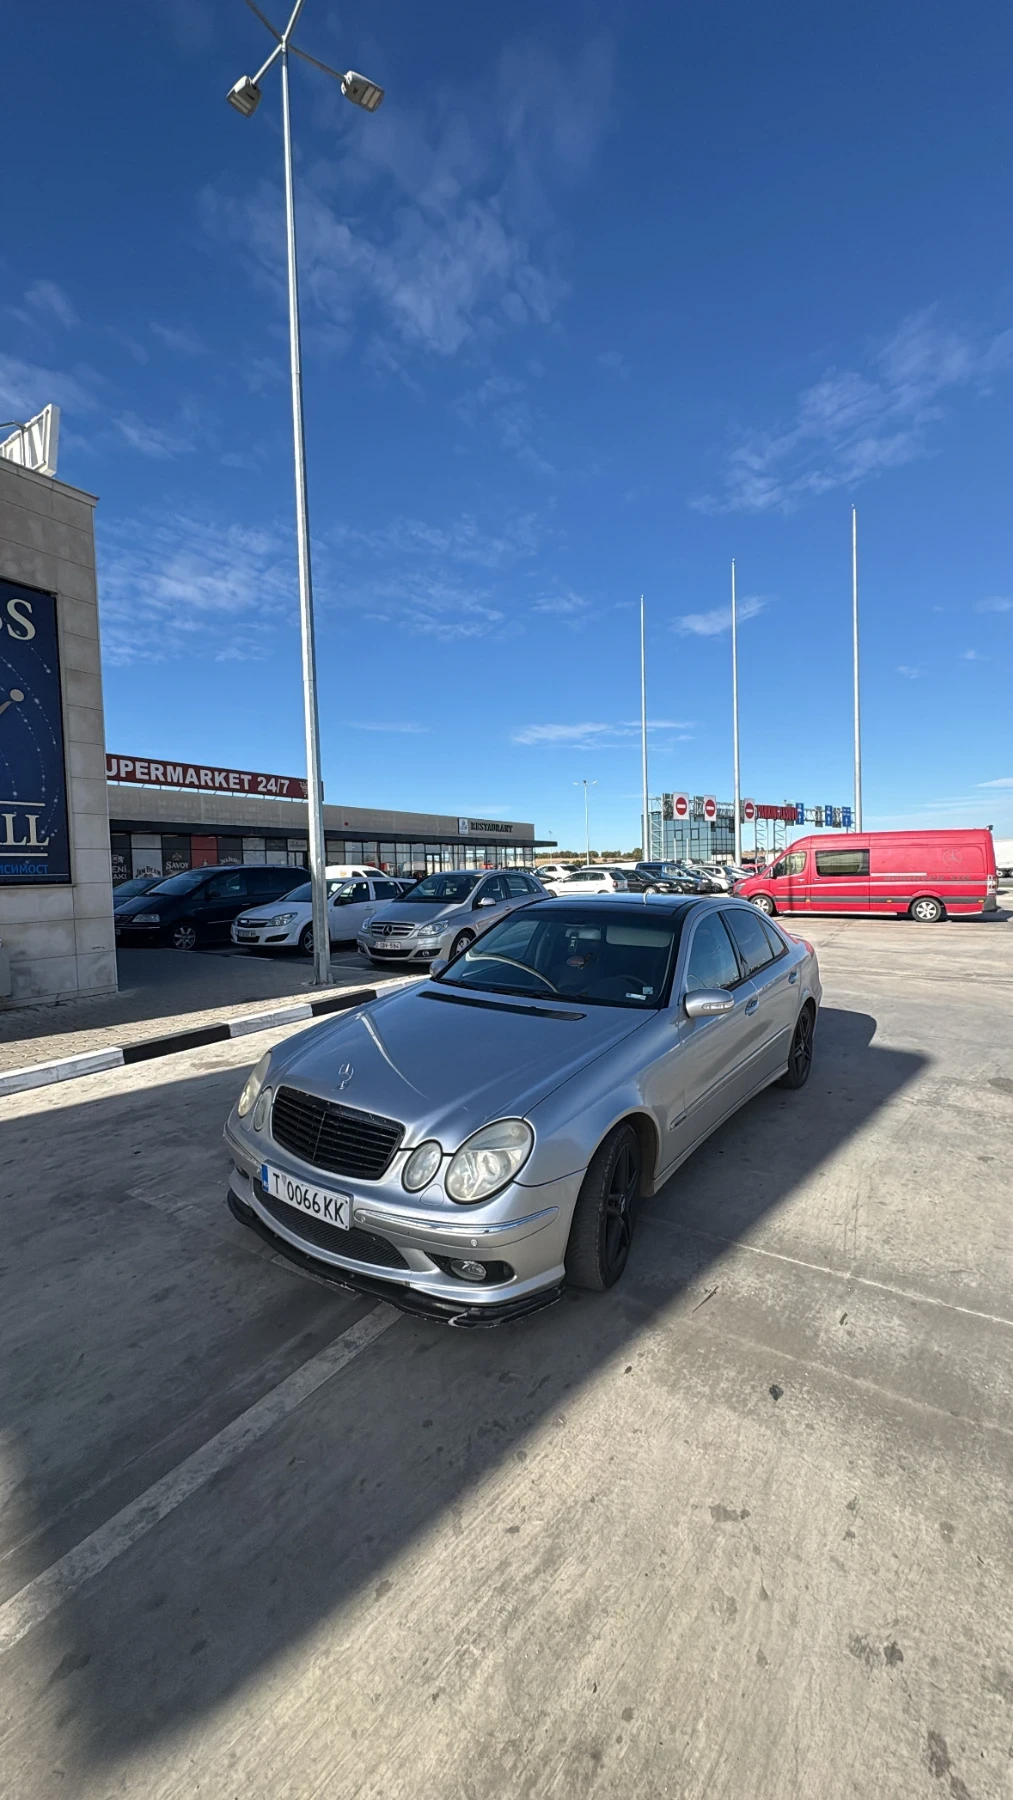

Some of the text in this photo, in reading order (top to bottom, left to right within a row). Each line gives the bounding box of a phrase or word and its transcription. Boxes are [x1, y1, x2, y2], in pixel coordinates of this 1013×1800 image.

[0, 599, 36, 640] S
[106, 758, 290, 794] UPERMARKET 24/7
[0, 813, 49, 846] LL
[470, 821, 513, 833] RESTAURANT
[165, 861, 190, 870] SAVOY
